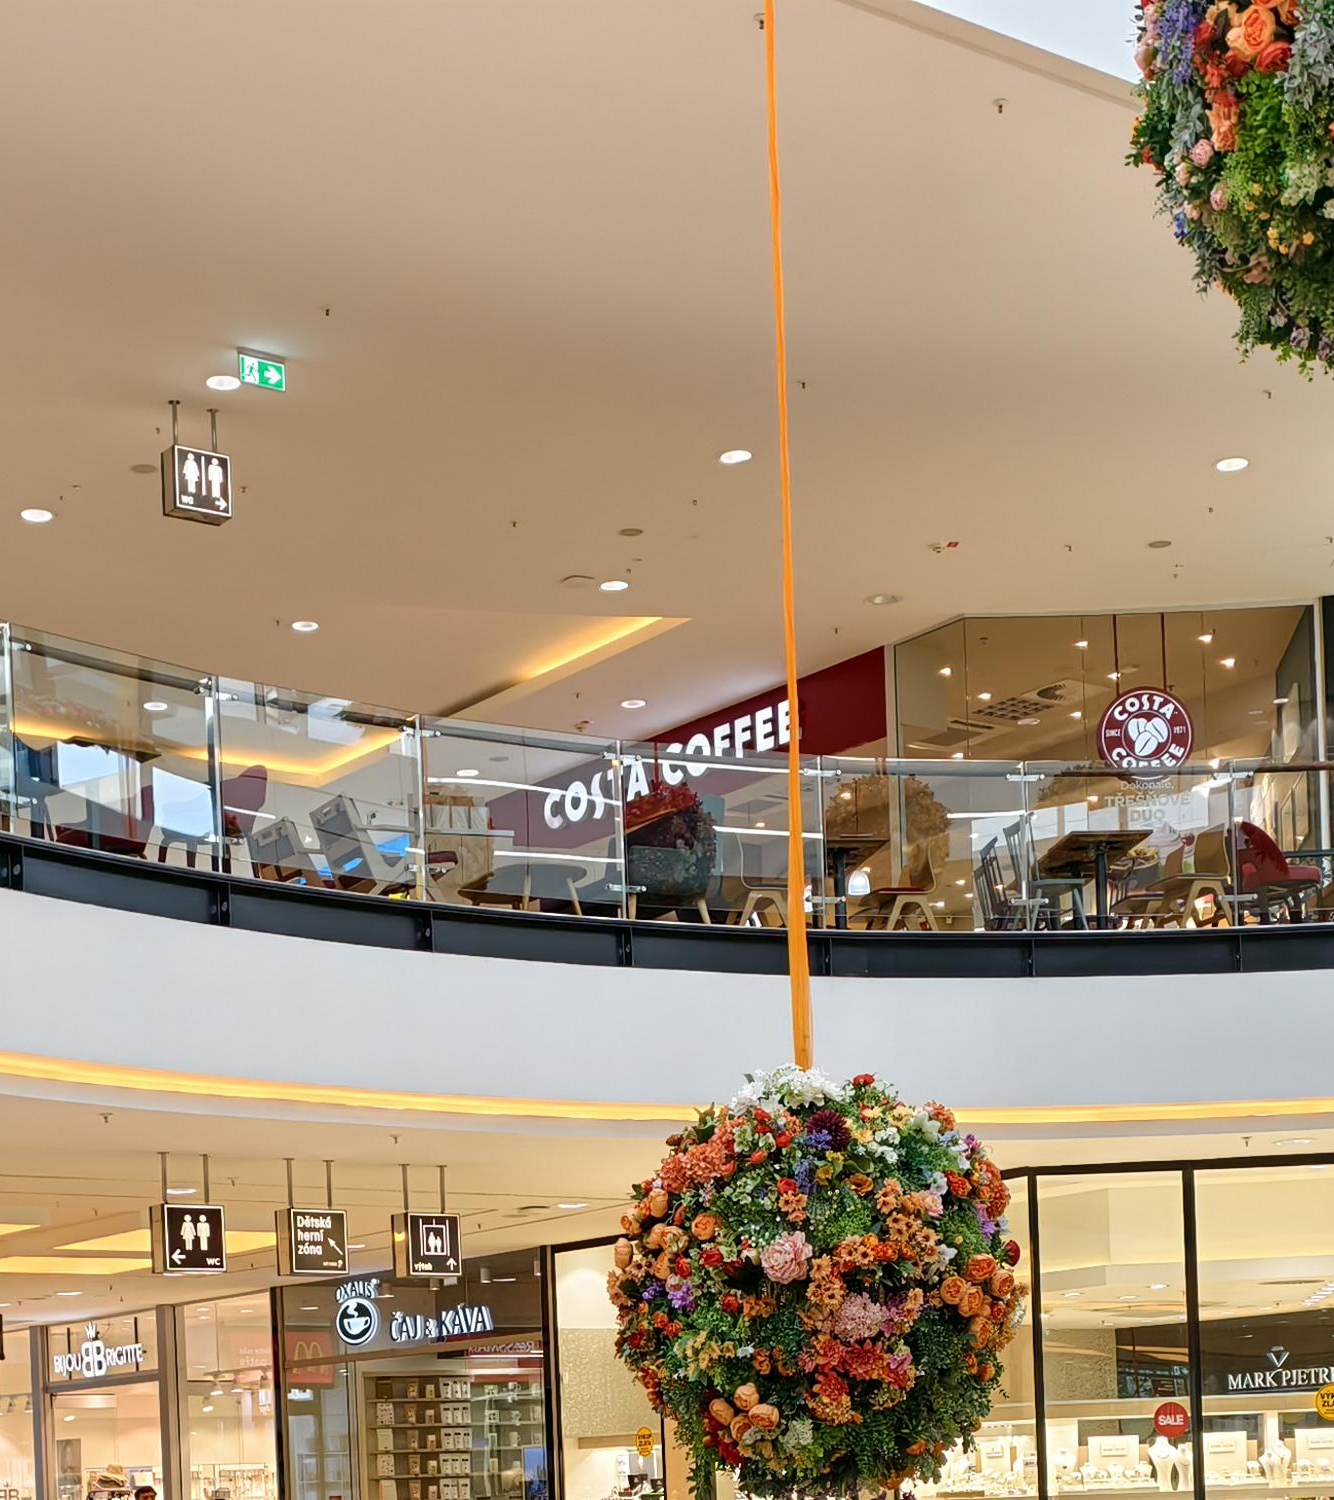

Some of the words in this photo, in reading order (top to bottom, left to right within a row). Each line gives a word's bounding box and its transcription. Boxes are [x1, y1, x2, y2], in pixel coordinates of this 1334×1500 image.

[1113, 694, 1176, 721] COSTA
[1130, 809, 1166, 823] DUO
[296, 1214, 332, 1229] Dětská
[296, 1229, 324, 1242] herní
[296, 1244, 323, 1256] zóna
[205, 1257, 221, 1267] WC
[334, 1281, 378, 1302] OXALIS
[390, 1311, 424, 1343] ČAJ
[424, 1319, 438, 1338] &
[438, 1303, 494, 1336] KÁVA
[53, 1353, 82, 1377] BIJOU
[1227, 1368, 1279, 1391] MARK
[1157, 1413, 1185, 1427] SALE
